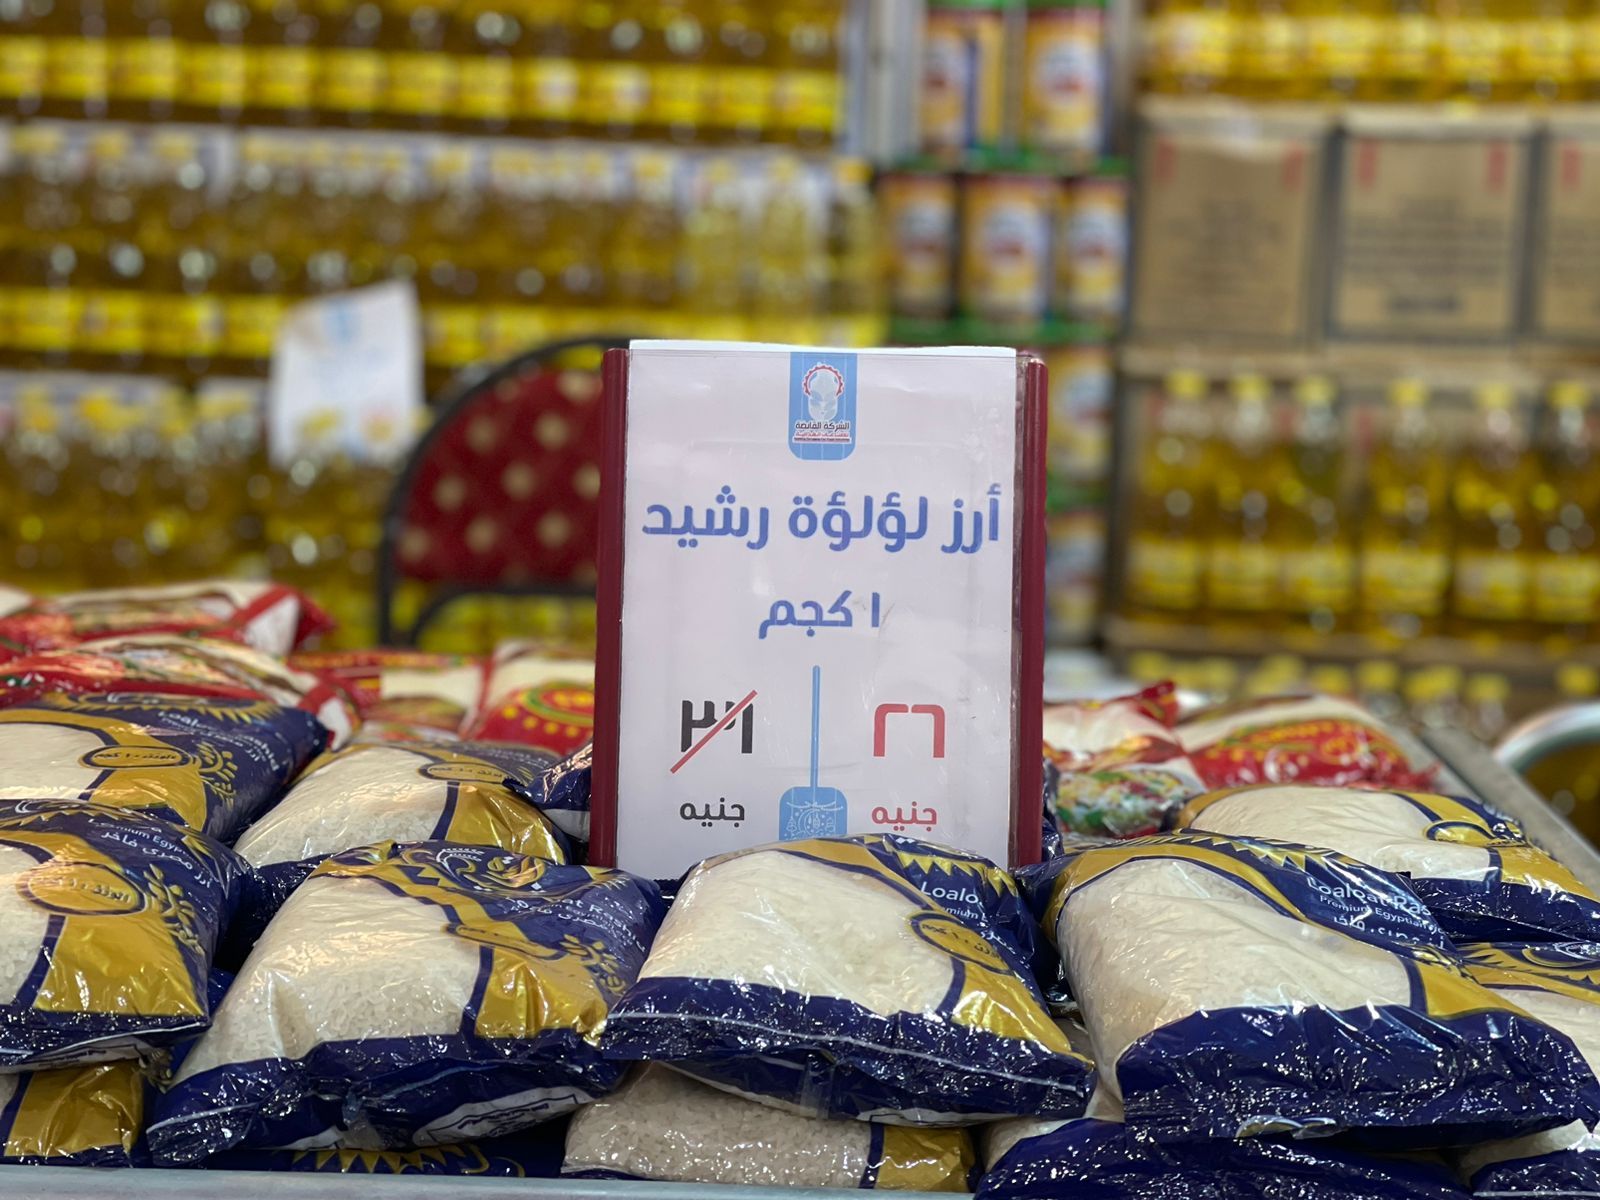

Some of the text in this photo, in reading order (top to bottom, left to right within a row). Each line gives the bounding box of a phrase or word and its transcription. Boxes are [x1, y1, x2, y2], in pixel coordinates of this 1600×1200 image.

[642, 483, 1001, 554] أرز لؤلؤة رشيد
[758, 590, 881, 640] ١ كجم
[873, 703, 946, 759] ٢٦
[679, 797, 746, 829] جنيه
[871, 801, 938, 832] جنيه
[1392, 894, 1432, 917] Ras
